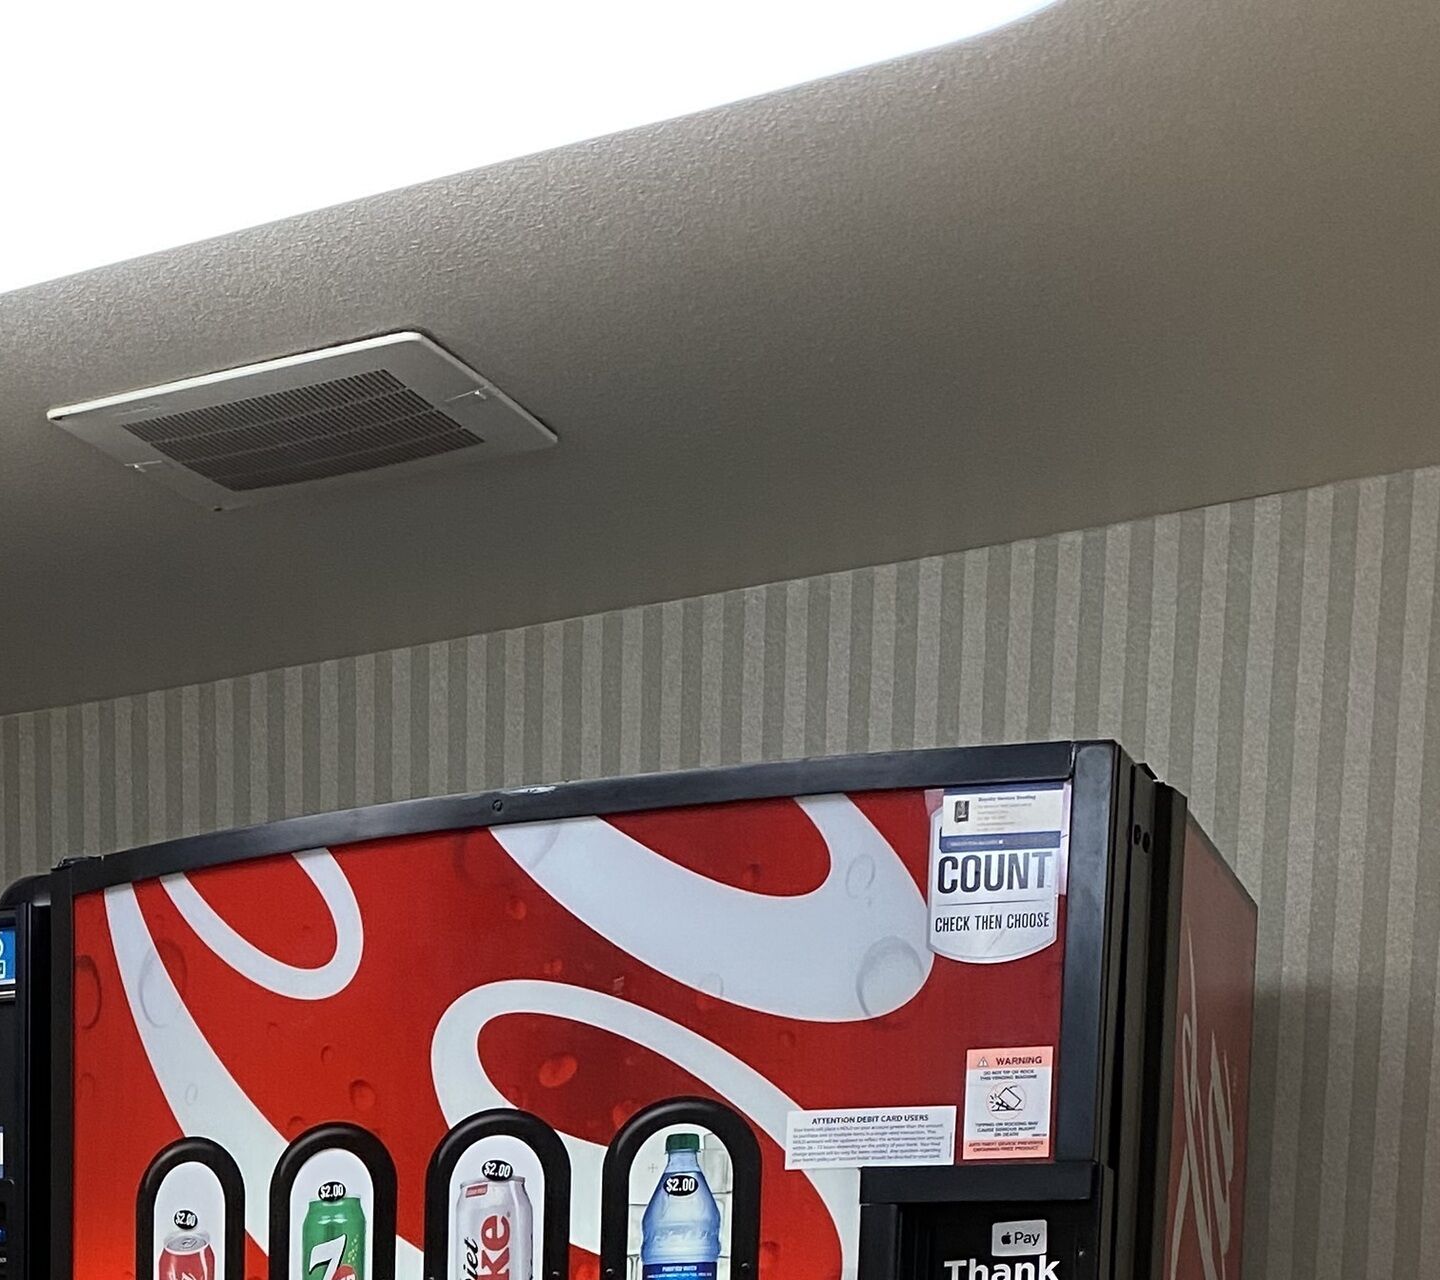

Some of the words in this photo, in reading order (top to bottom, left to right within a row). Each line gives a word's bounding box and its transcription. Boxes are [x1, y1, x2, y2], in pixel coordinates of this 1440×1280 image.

[937, 851, 1053, 894] COUNT
[935, 915, 970, 932] CHECK
[974, 913, 1002, 930] THEN
[1006, 911, 1050, 929] CHOOSE
[995, 1056, 1043, 1066] WARNING
[811, 1115, 856, 1125] ATTENTION
[856, 1115, 879, 1124] DEBIT
[880, 1114, 903, 1123] CARD
[904, 1113, 929, 1122] USERS
[483, 1162, 512, 1178] $2.00
[319, 1184, 345, 1200] $2.00
[665, 1177, 696, 1193] $2.00
[175, 1212, 196, 1228] $2.00
[1014, 1231, 1041, 1246] Pay
